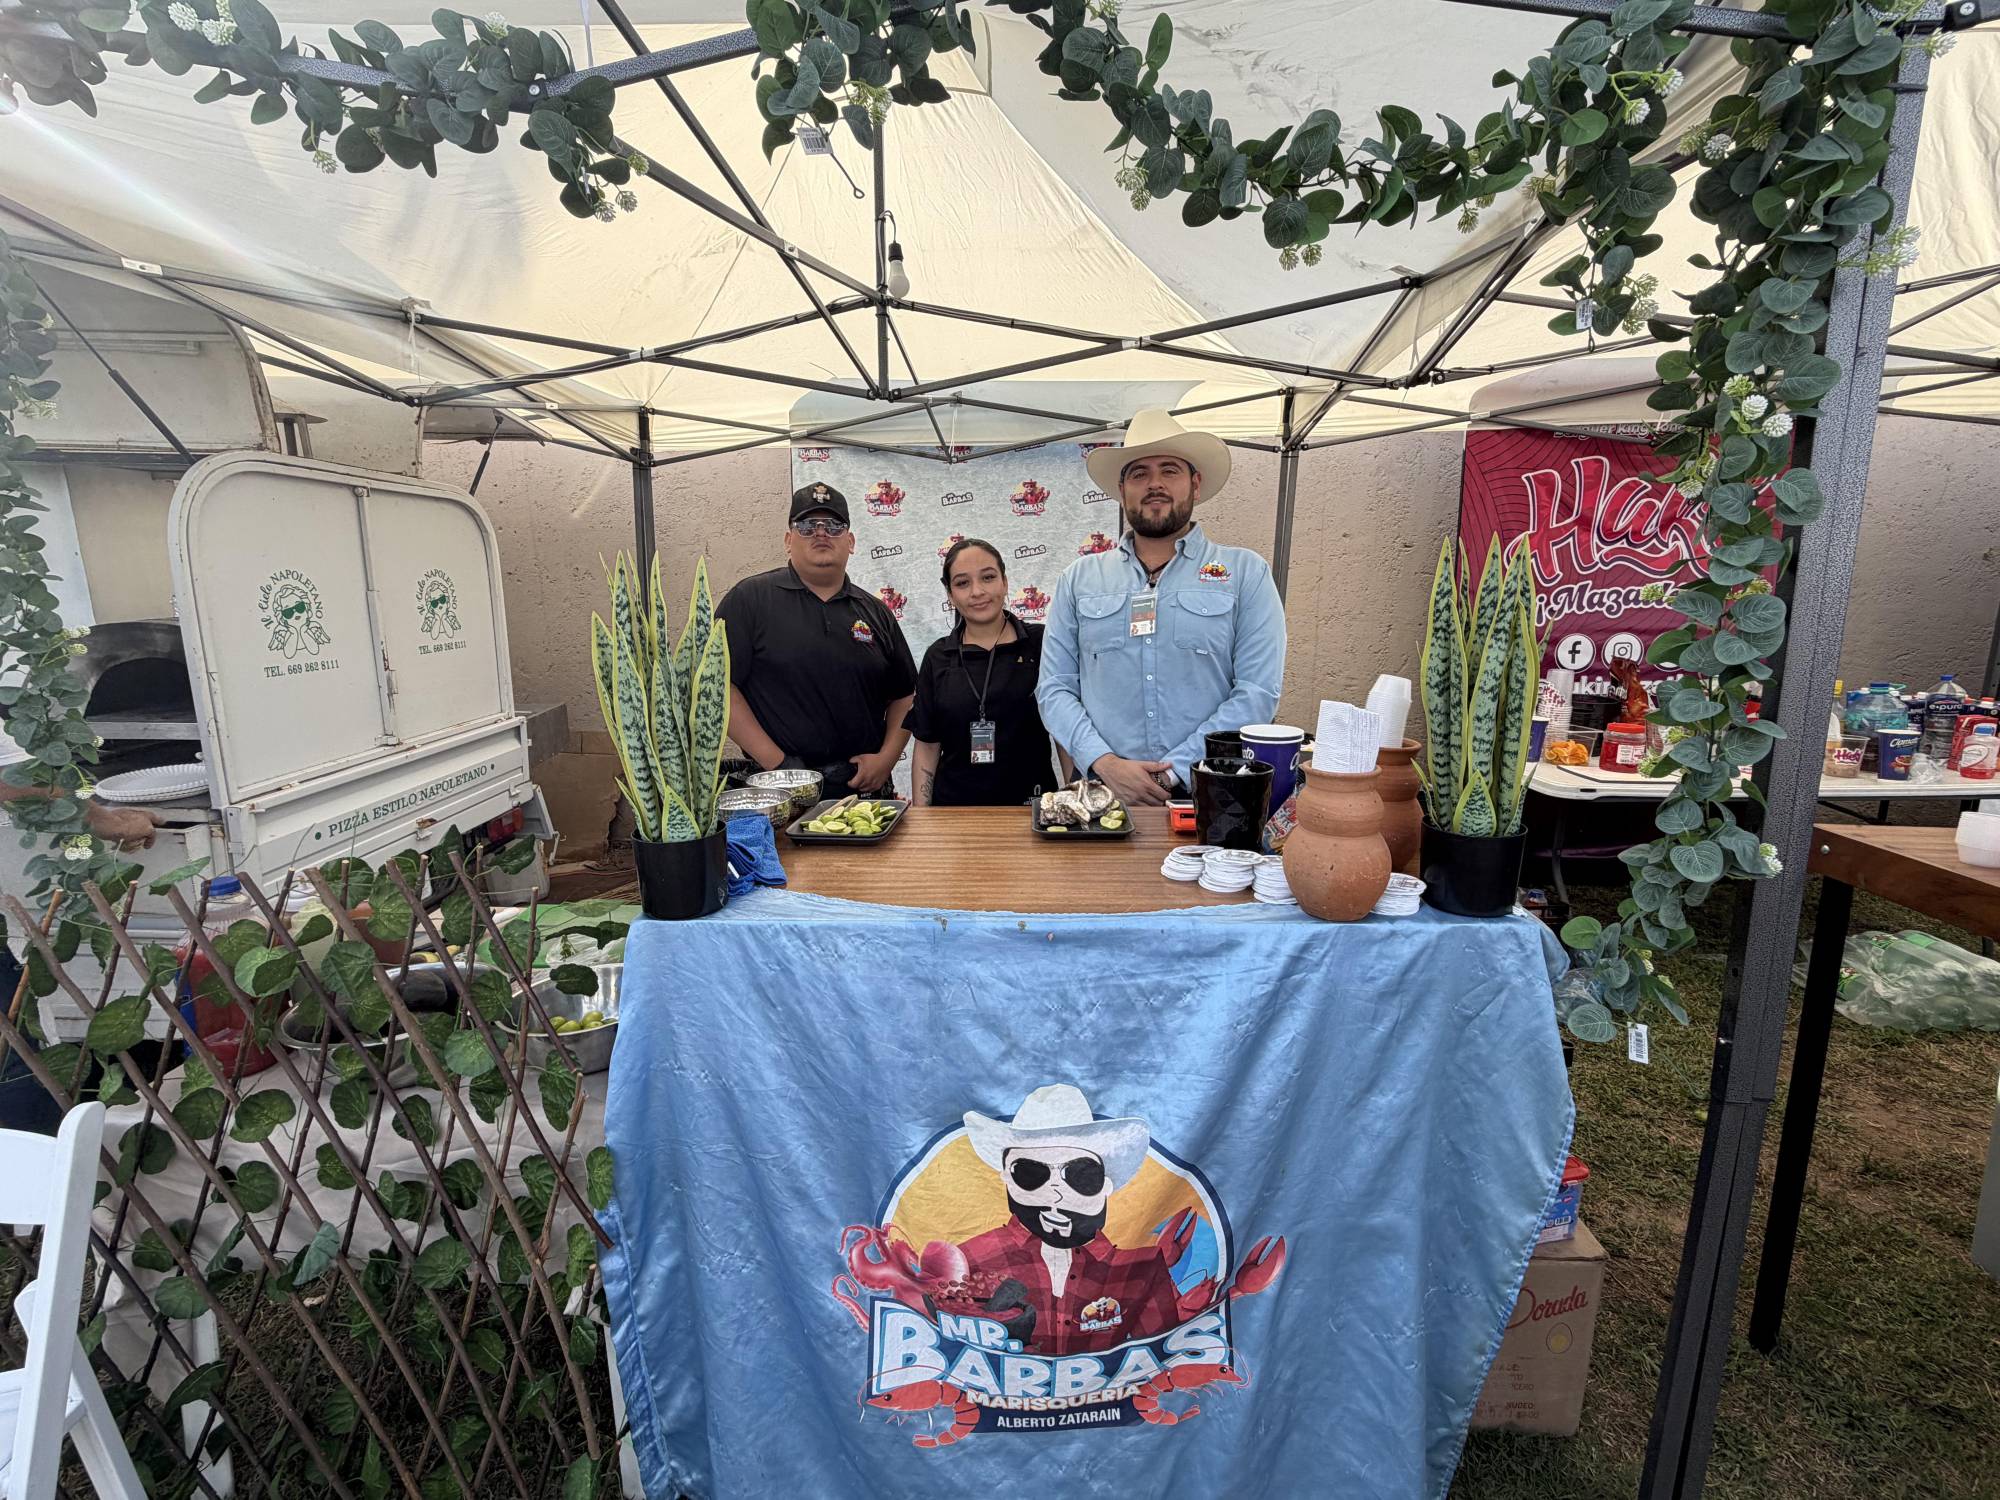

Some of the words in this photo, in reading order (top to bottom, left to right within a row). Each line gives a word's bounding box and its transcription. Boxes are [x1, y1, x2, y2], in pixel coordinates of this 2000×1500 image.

[1013, 503, 1044, 512] BARBAS
[258, 585, 273, 612] Cielo
[270, 569, 324, 619] NAPOLETANO
[424, 568, 457, 610] NAPOLETANO
[418, 645, 432, 655] TEL.
[264, 666, 286, 678] TEL.
[288, 664, 302, 675] 669
[305, 662, 319, 672] 262
[321, 659, 340, 670] 8111
[328, 811, 370, 839] PIZZA
[372, 793, 418, 820] ESTILO
[419, 764, 488, 801] NAPOLETANO
[936, 1310, 1022, 1352] MR.
[876, 1307, 1227, 1397] BARBAS
[966, 1383, 1142, 1411] MARISQUERIA
[997, 1415, 1056, 1429] ALBERTO
[1058, 1407, 1121, 1426] ZATARAIN
